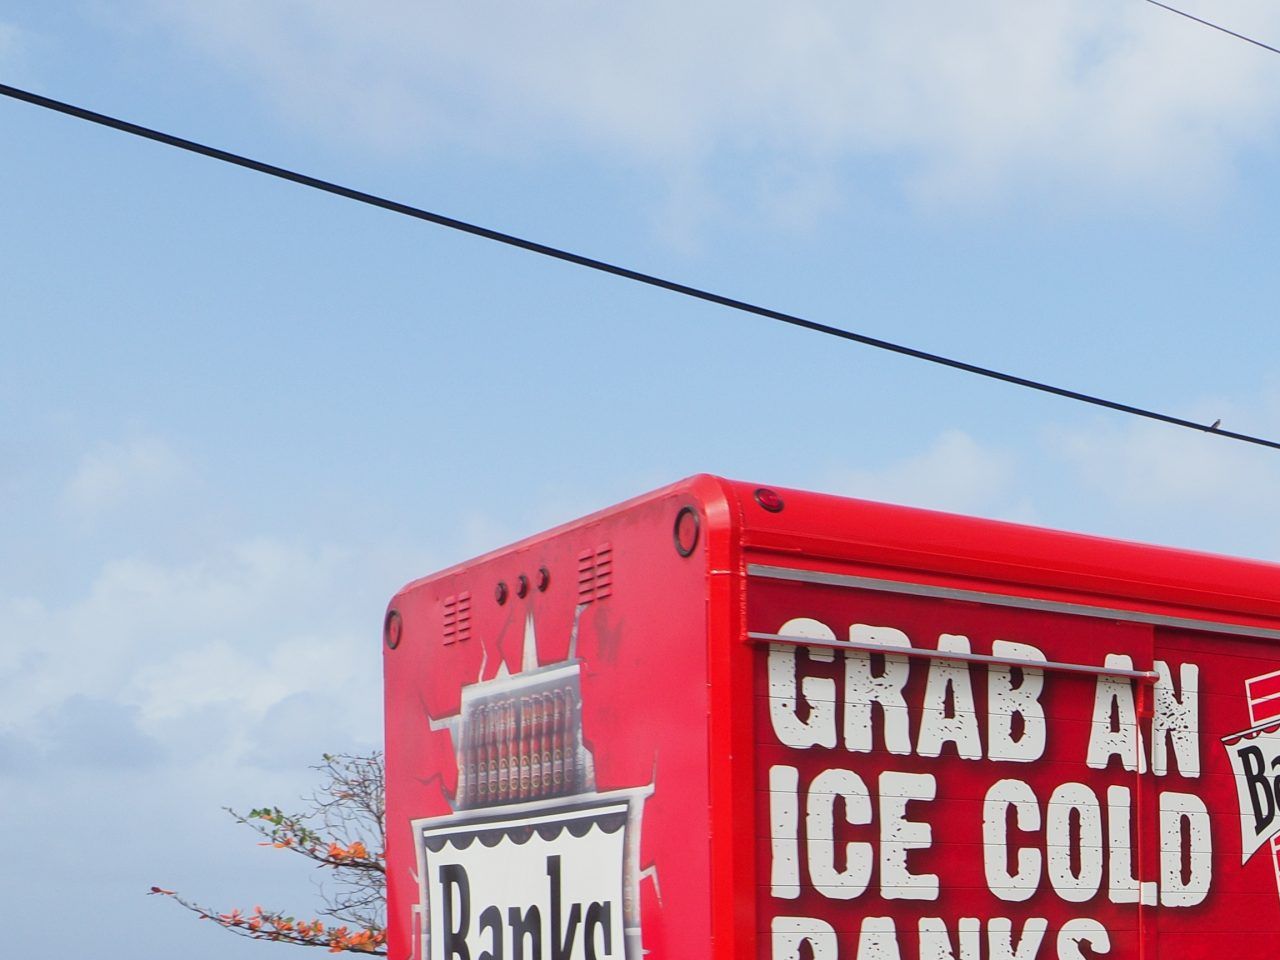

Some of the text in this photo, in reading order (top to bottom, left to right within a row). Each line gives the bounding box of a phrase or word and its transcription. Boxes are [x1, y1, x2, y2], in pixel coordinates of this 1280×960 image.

[767, 617, 1200, 778] GRAB AN
[769, 765, 1213, 907] ICE COLD
